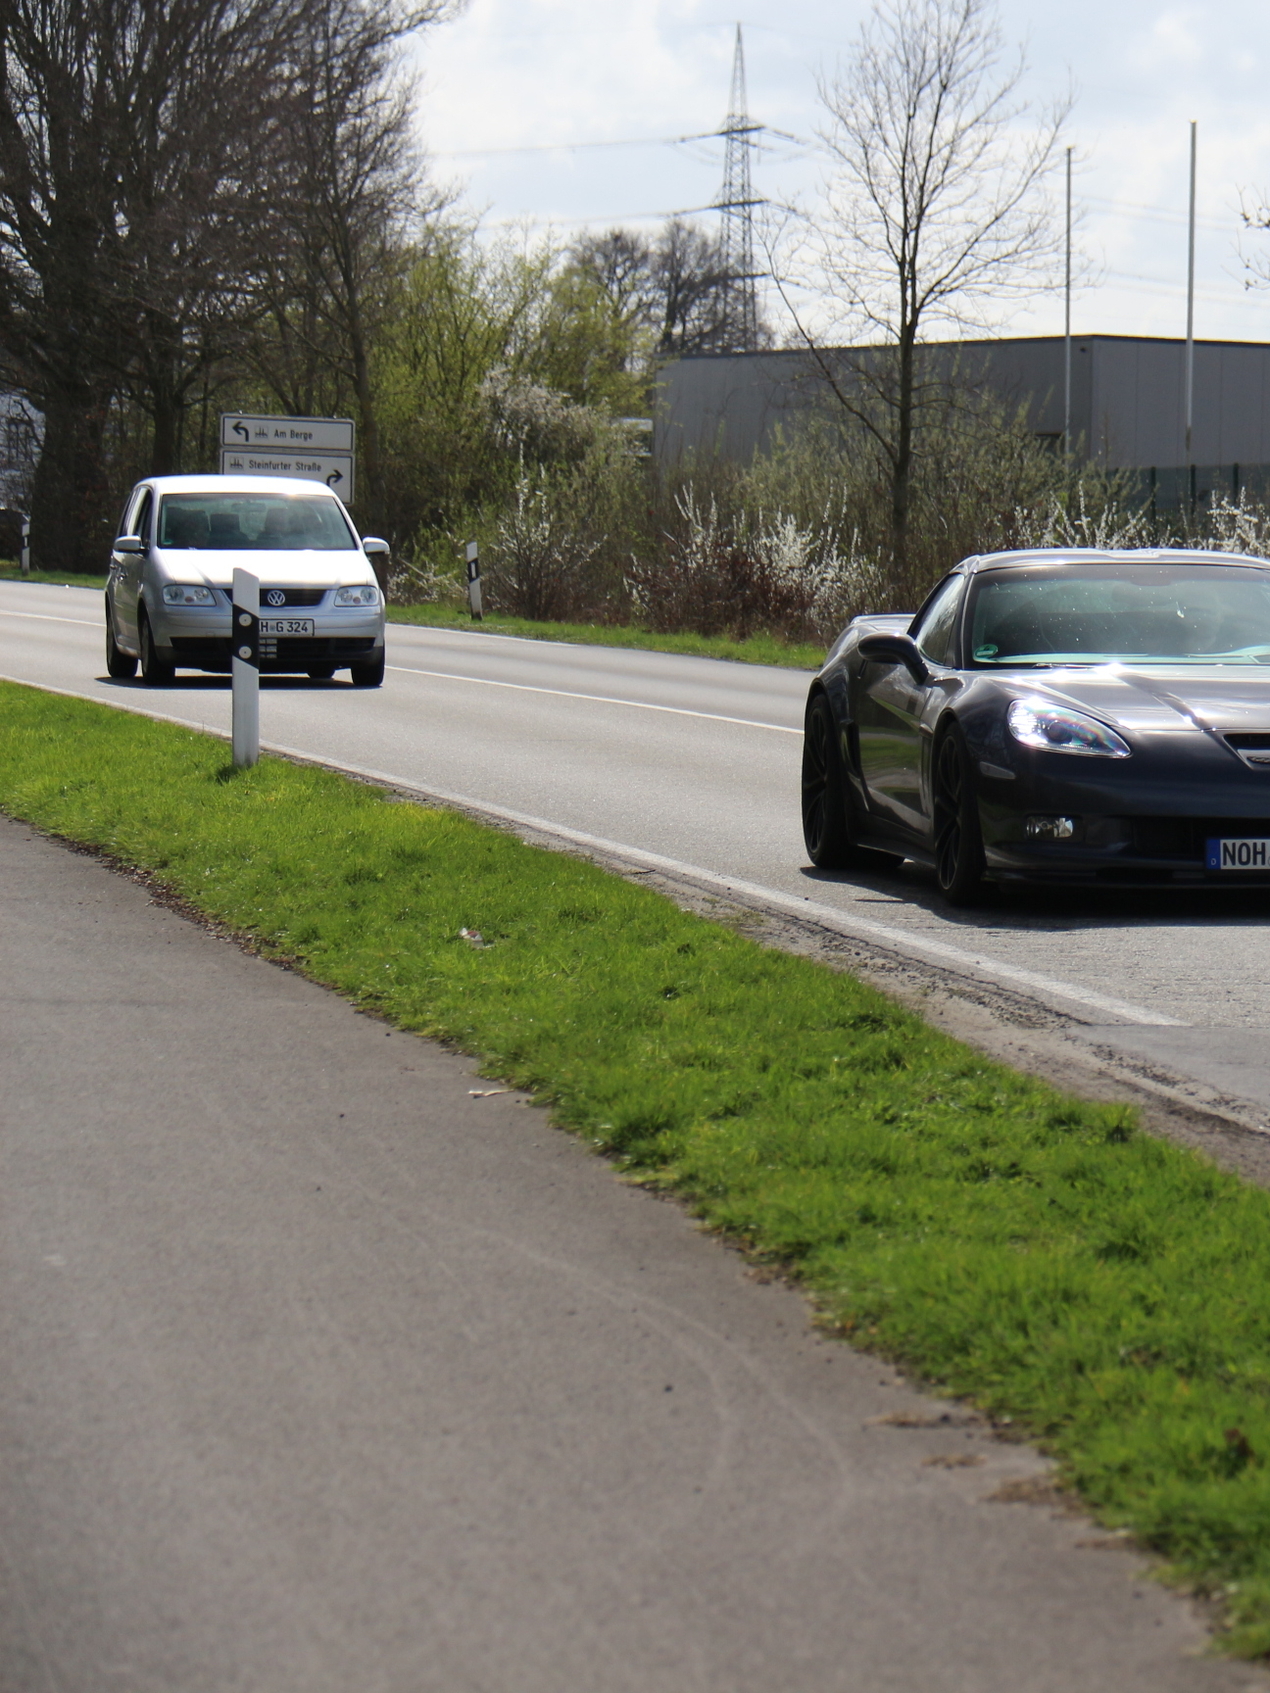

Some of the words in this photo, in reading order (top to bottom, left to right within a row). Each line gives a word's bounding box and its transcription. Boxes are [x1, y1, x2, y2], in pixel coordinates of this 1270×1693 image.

[274, 430, 286, 438] Am
[290, 430, 313, 441] Berge
[249, 460, 291, 470] Steinfurter
[296, 462, 322, 472] Straße
[276, 621, 284, 632] G
[286, 621, 308, 632] 324
[1222, 842, 1266, 866] NOH
